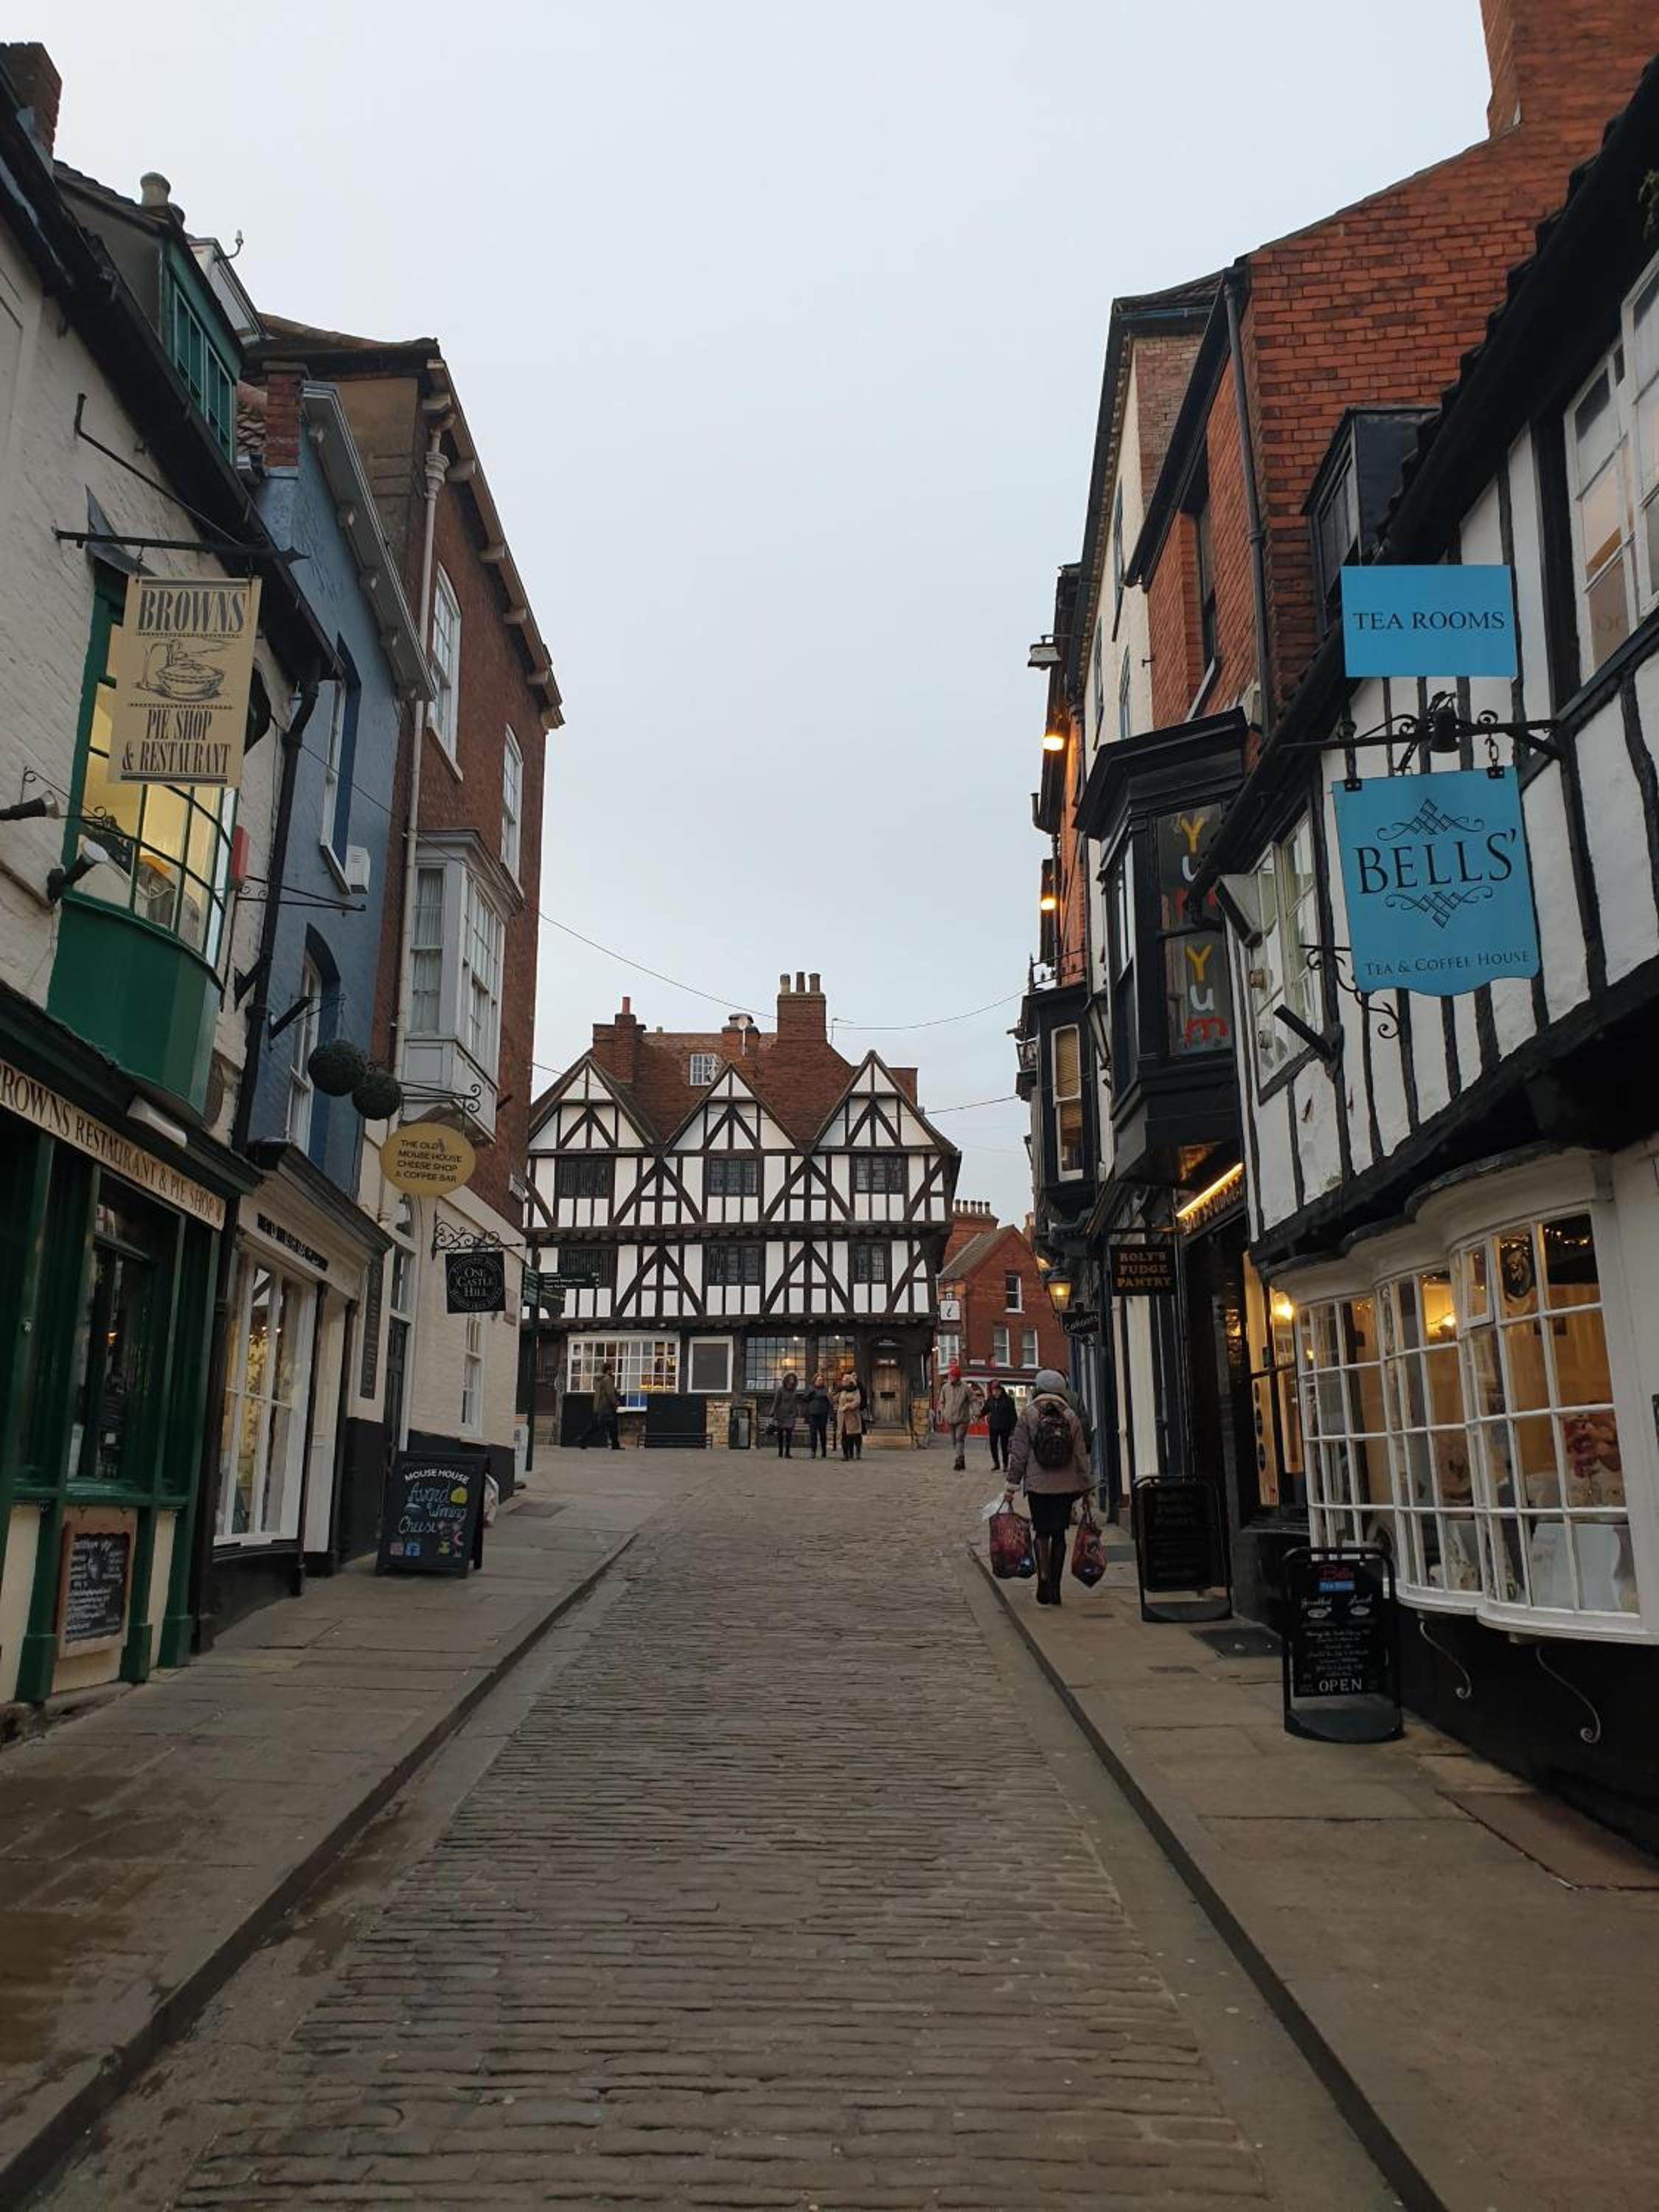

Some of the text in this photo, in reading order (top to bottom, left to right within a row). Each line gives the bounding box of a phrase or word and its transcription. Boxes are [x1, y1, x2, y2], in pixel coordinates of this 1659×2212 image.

[138, 590, 246, 633] BROWNS
[1353, 611, 1505, 630] TEA ROOMS
[147, 709, 212, 741] PIE SHOP
[122, 740, 231, 774] & RESTAURANT
[1354, 828, 1516, 894] BELLS'
[1366, 950, 1529, 975] TEA & COFFEE HOUSE
[0, 1062, 215, 1218] ROWNS RESTAURANT & PIE SHOP
[401, 1139, 438, 1150] THE OLD
[398, 1150, 462, 1163] MOUSE HOUSE
[397, 1161, 458, 1172] CHEESE SHOP
[403, 1171, 438, 1180] COFFEE
[439, 1175, 457, 1183] BAR
[1120, 1265, 1169, 1275] FUDGE
[1116, 1276, 1172, 1288] PANTRY
[406, 1469, 470, 1484] MOUSE HOUSE
[1319, 1677, 1363, 1692] OPEN
